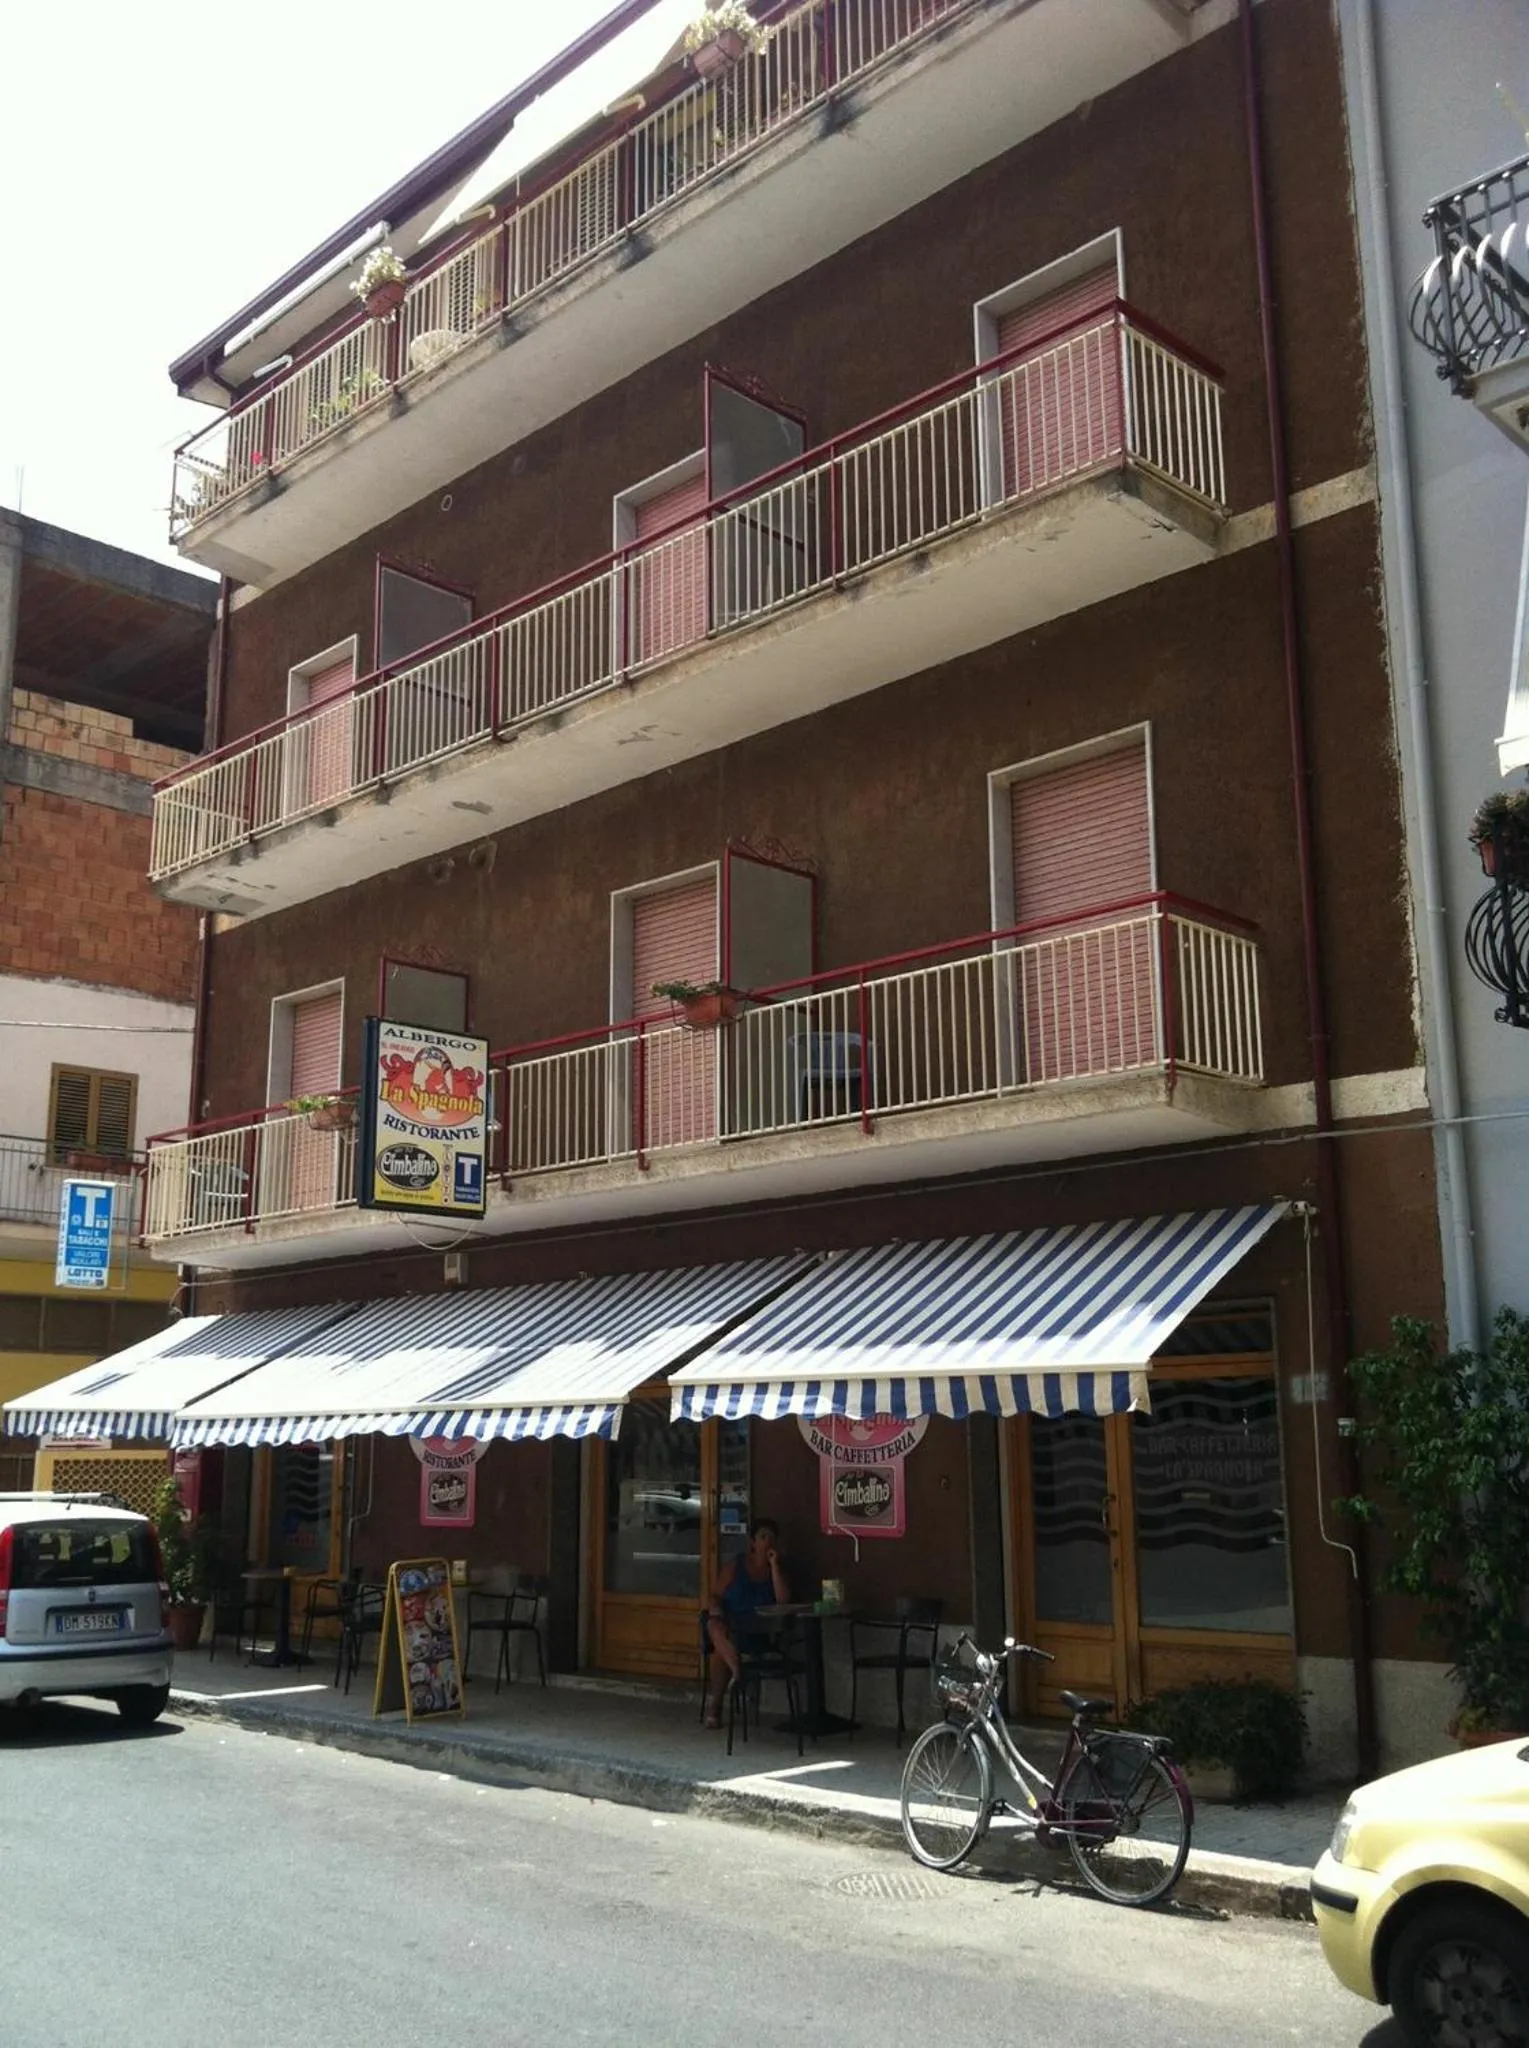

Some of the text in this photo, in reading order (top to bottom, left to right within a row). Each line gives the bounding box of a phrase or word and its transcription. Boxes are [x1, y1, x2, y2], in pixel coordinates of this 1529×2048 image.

[384, 1027, 478, 1051] ALBERGO
[379, 1079, 484, 1115] La Spagnola
[383, 1113, 481, 1141] RISTORANTE
[382, 1151, 438, 1176] Cimbalino
[458, 1156, 478, 1184] T
[76, 1187, 107, 1228] T
[68, 1235, 107, 1246] TABACCHI
[68, 1268, 103, 1278] LOTTO
[422, 1448, 477, 1469] RISTORANTE
[810, 1430, 917, 1464] BAR CAFFETTERIA
[835, 1476, 890, 1507] Cimbalino
